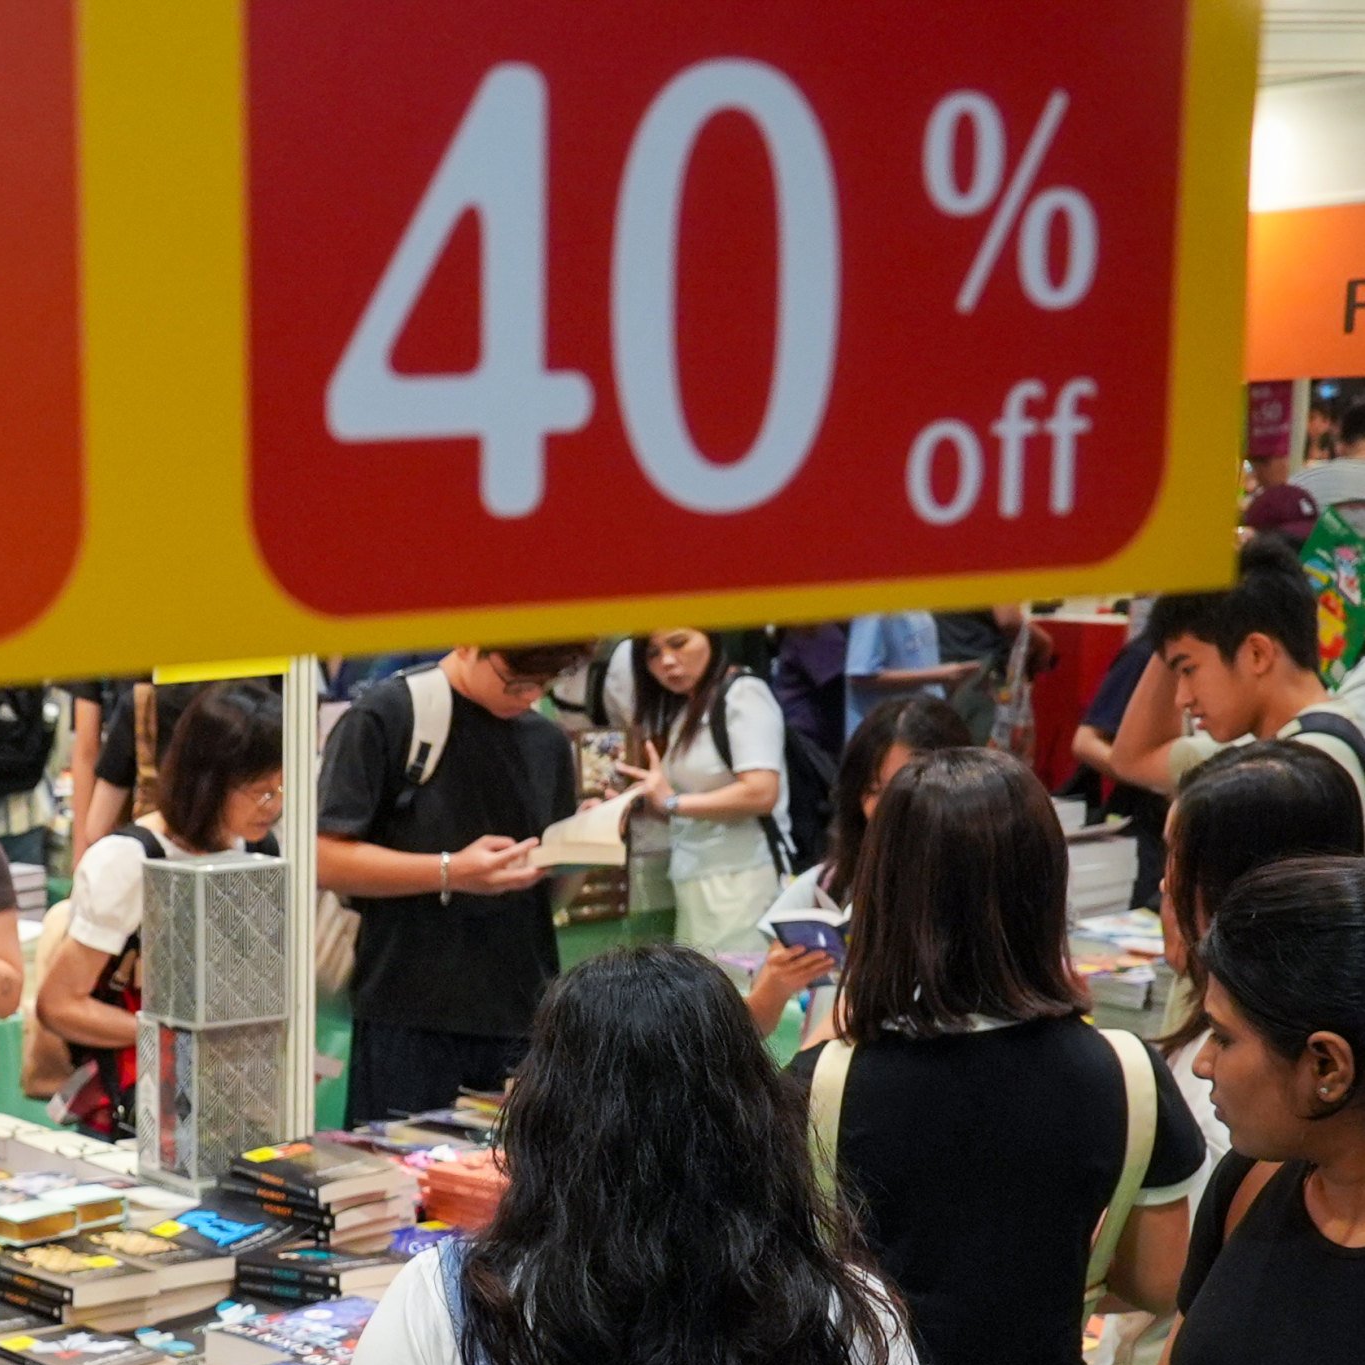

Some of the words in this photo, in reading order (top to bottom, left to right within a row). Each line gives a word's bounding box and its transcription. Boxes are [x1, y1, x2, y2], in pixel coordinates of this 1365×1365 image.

[326, 56, 842, 518] 40
[921, 88, 1099, 316] %
[905, 376, 1097, 526] off
